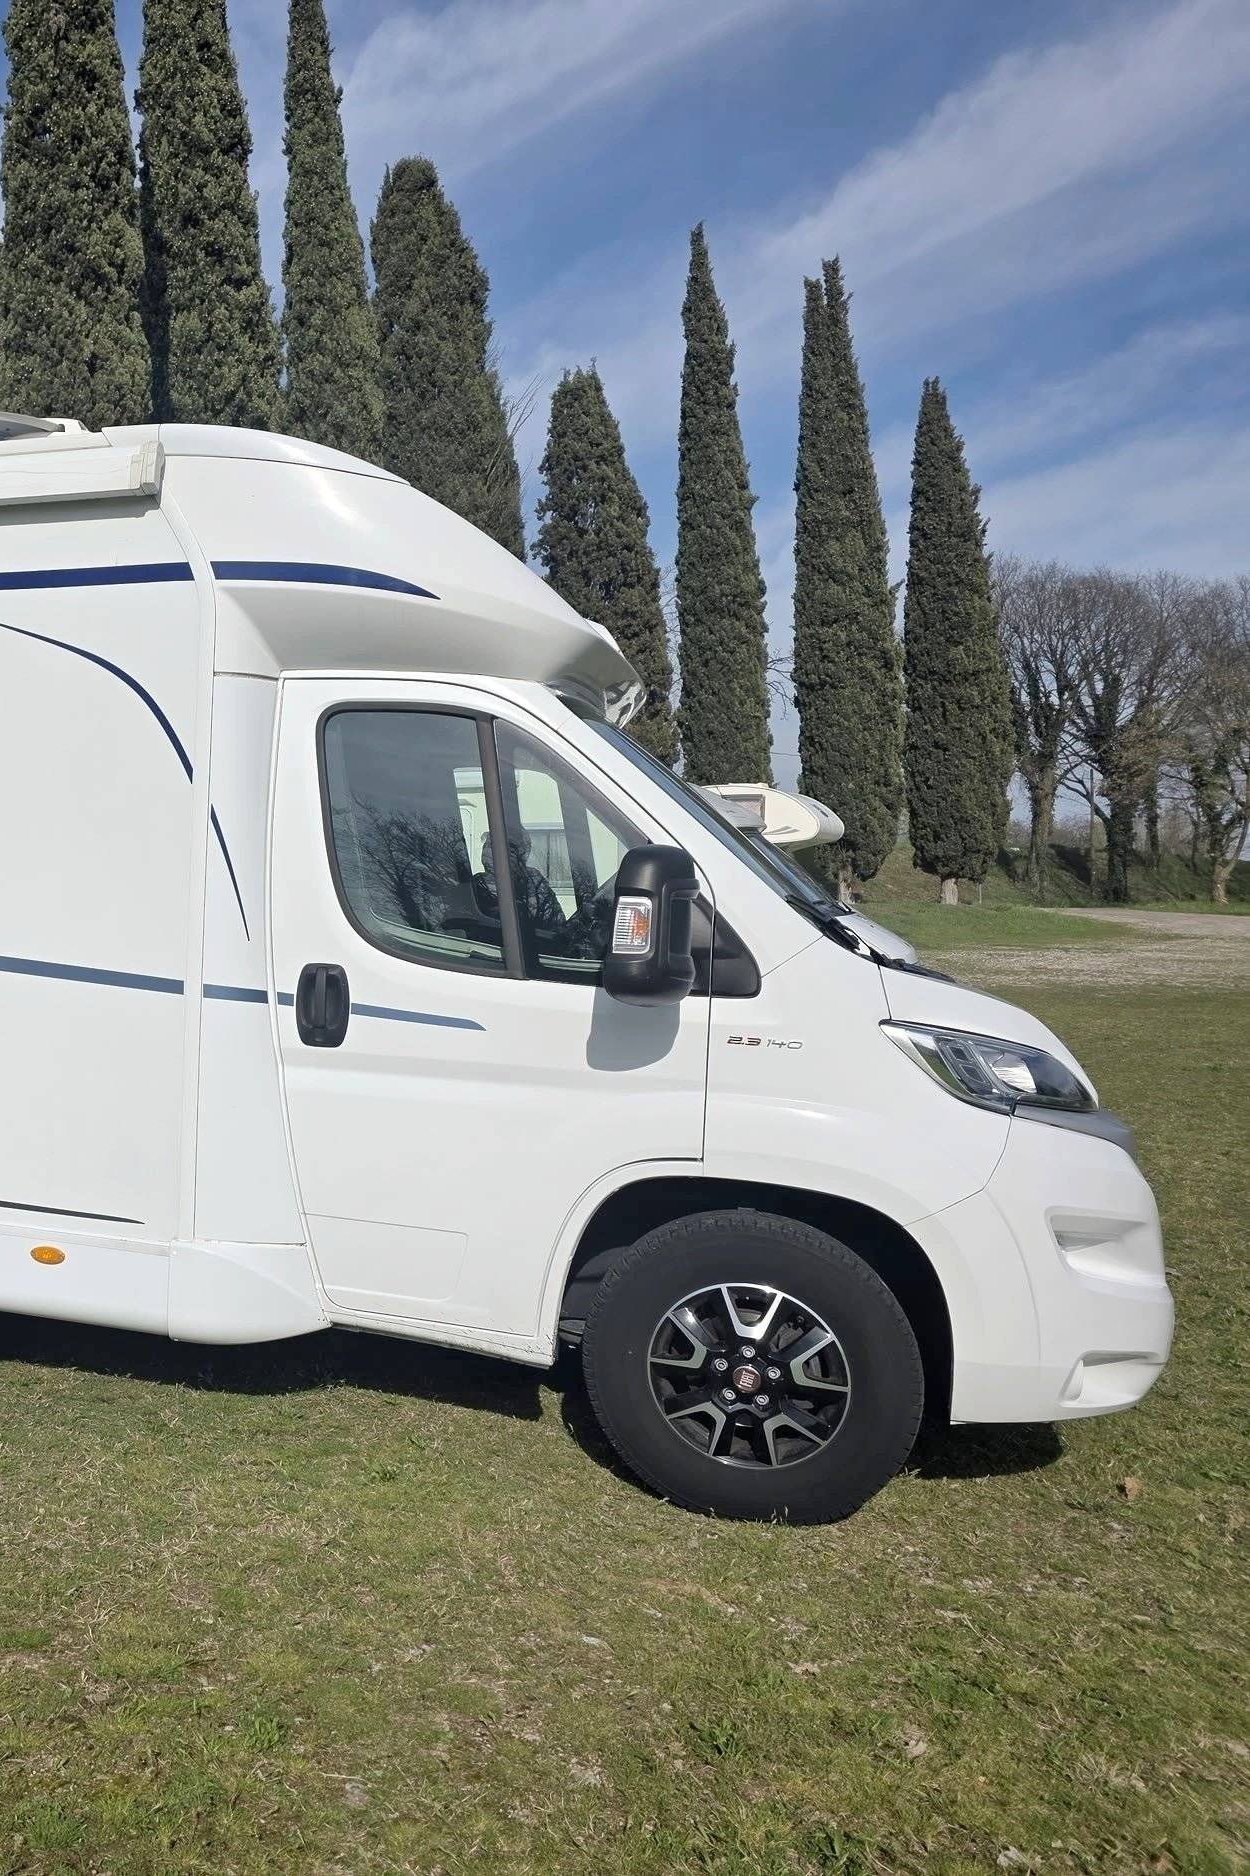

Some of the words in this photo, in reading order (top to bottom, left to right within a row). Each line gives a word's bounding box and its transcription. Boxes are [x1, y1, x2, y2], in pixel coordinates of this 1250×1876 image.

[727, 1035, 762, 1046] 2.3
[766, 1039, 803, 1050] 140
[739, 1370, 755, 1388] FIAT
